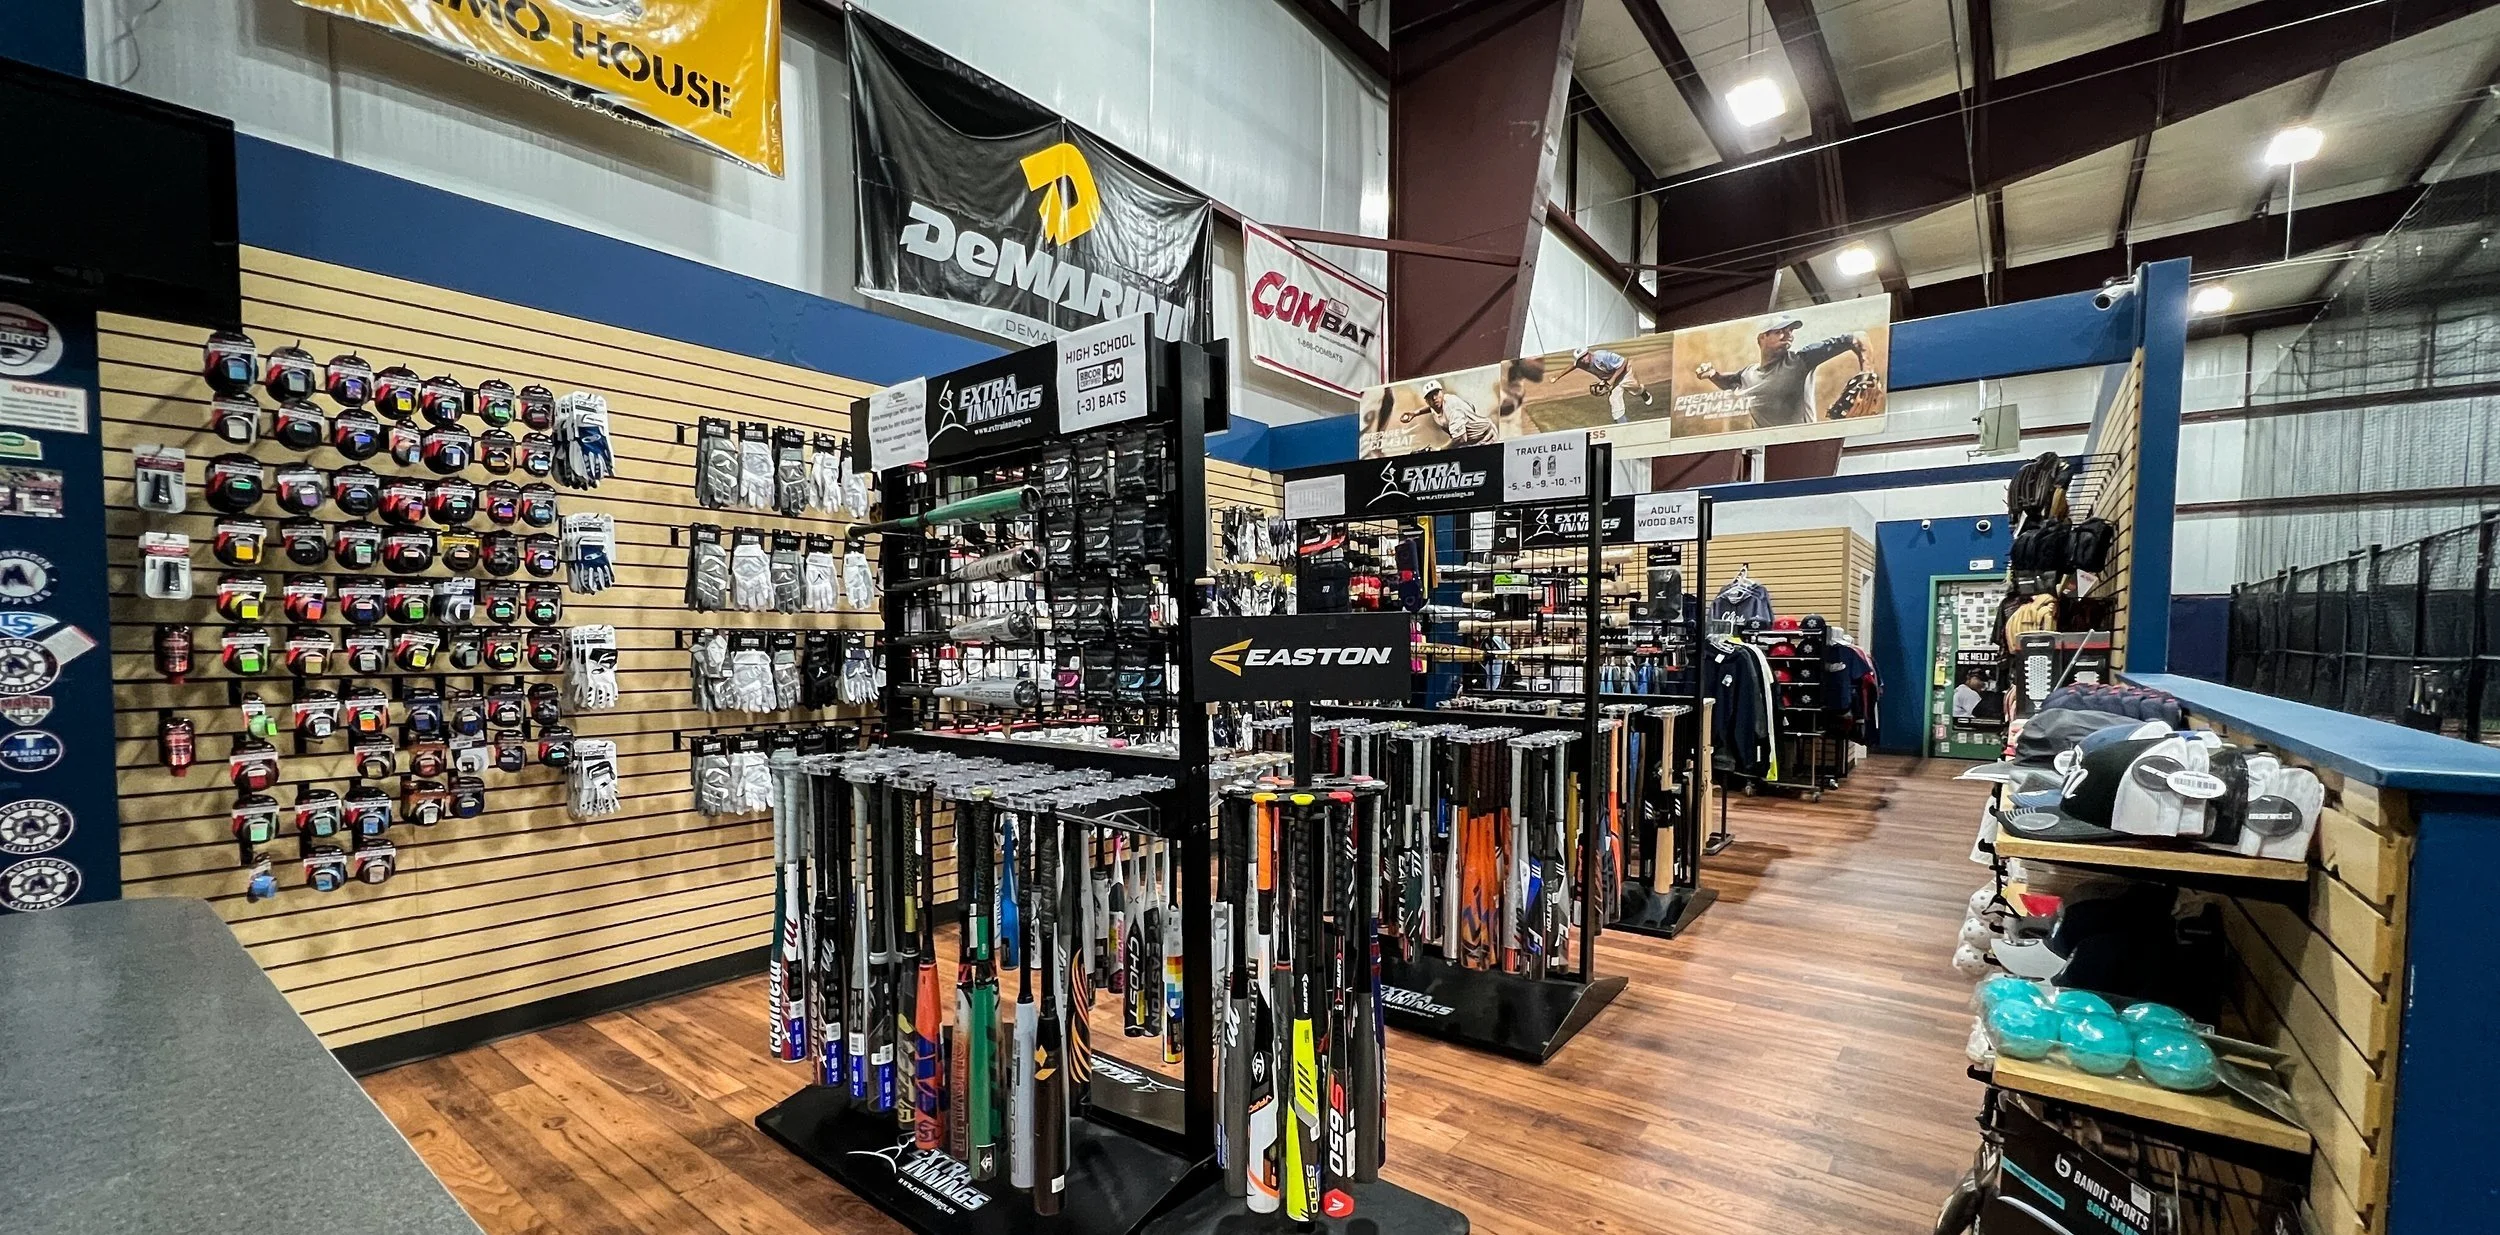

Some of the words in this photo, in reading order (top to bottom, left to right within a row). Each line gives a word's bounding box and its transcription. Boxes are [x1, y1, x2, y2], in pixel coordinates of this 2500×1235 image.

[572, 22, 733, 119] HOUSE
[1065, 346, 1091, 364] HIGH
[1093, 333, 1136, 356] SCHOOL
[1103, 362, 1123, 383] .50
[11, 384, 67, 398] NOTICE!
[959, 374, 1017, 410] EXTRA
[1099, 390, 1126, 409] BATS
[965, 385, 1043, 426] INNINGS
[1685, 396, 1756, 417] COMBAT
[1516, 446, 1548, 456] TRAVEL
[1551, 442, 1573, 452] BALL
[1401, 461, 1461, 483] EXTRA
[1407, 471, 1487, 494] INNINGS
[1569, 476, 1581, 485] -11
[1651, 504, 1682, 515] ADULT
[1638, 518, 1667, 528] WOOD
[1670, 516, 1695, 526] BATS
[1244, 647, 1392, 666] EASTON
[1957, 652, 1970, 661] WE
[1970, 652, 1989, 661] HELD
[3, 748, 57, 758] TANNER
[1129, 936, 1142, 1023] GHOST
[1151, 942, 1162, 1029] EASTON
[770, 960, 782, 1053] marucci
[1329, 1073, 1345, 1177] S650
[899, 1159, 992, 1211] INNINGS
[1306, 1164, 1318, 1213] S500
[2073, 1170, 2110, 1203] BANDIT
[2109, 1195, 2150, 1231] SPORTS
